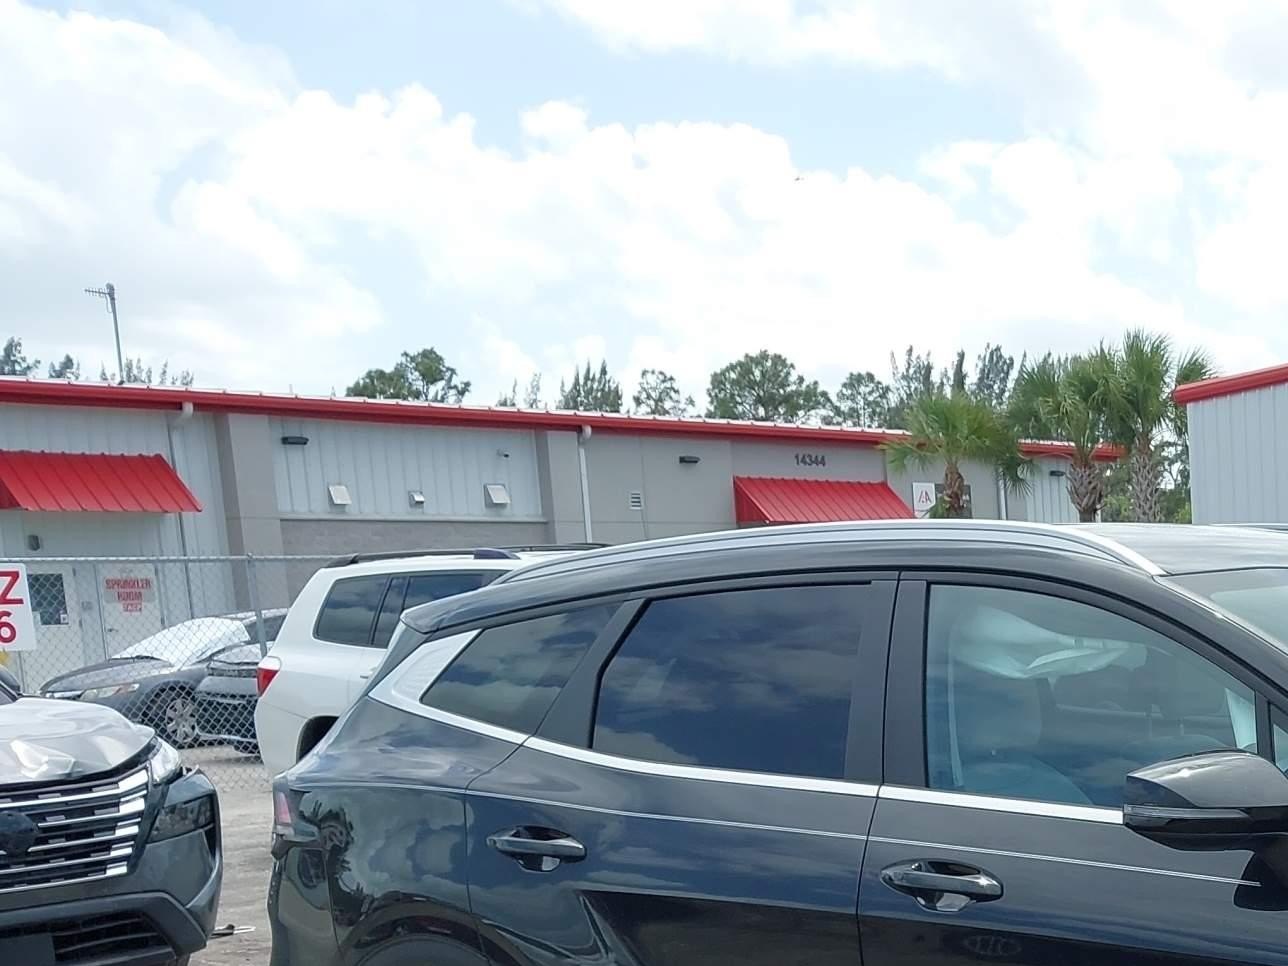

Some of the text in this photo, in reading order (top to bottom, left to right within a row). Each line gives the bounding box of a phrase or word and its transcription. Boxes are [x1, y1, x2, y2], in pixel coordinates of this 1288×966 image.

[794, 453, 826, 467] 14344
[105, 578, 152, 590] SPRINKLER
[117, 591, 143, 601] ROOM
